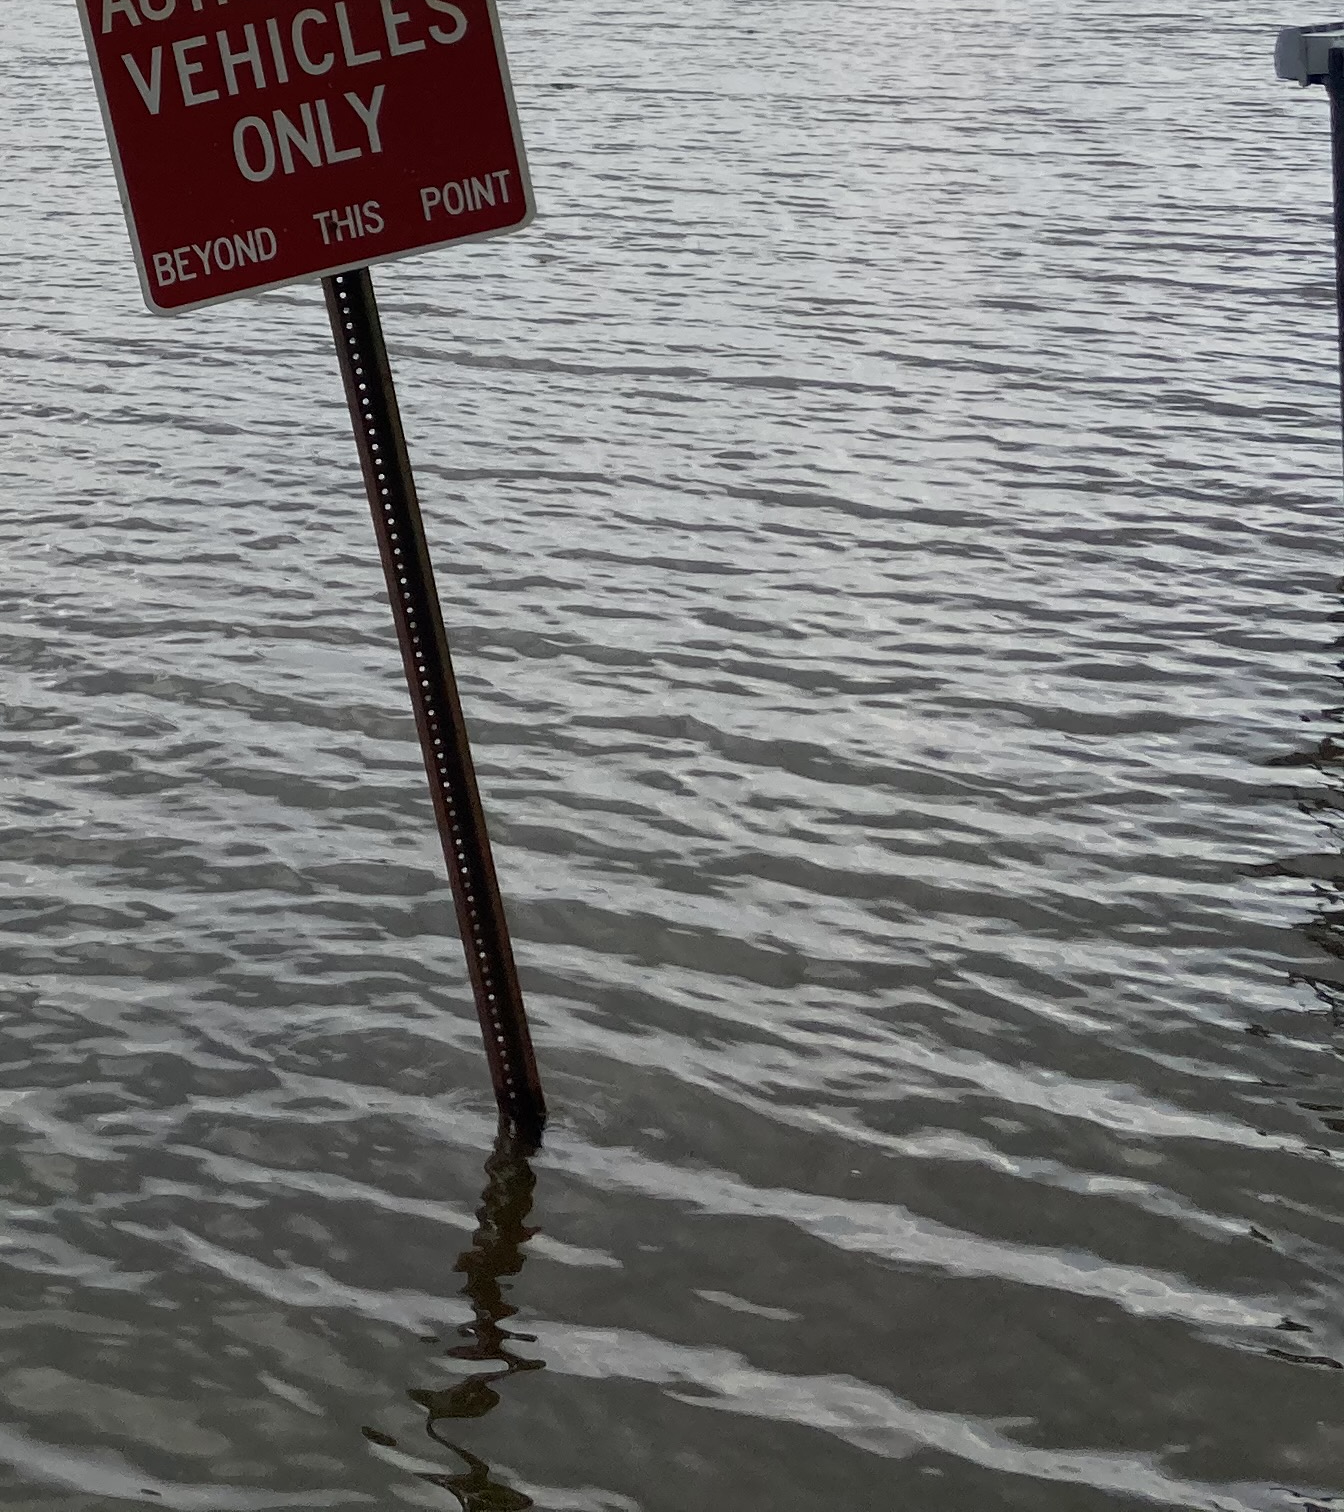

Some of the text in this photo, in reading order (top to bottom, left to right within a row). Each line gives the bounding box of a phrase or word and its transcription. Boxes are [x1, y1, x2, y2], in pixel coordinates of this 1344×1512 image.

[232, 84, 386, 182] ONLY
[152, 170, 511, 287] BEYOND THIS POINT
